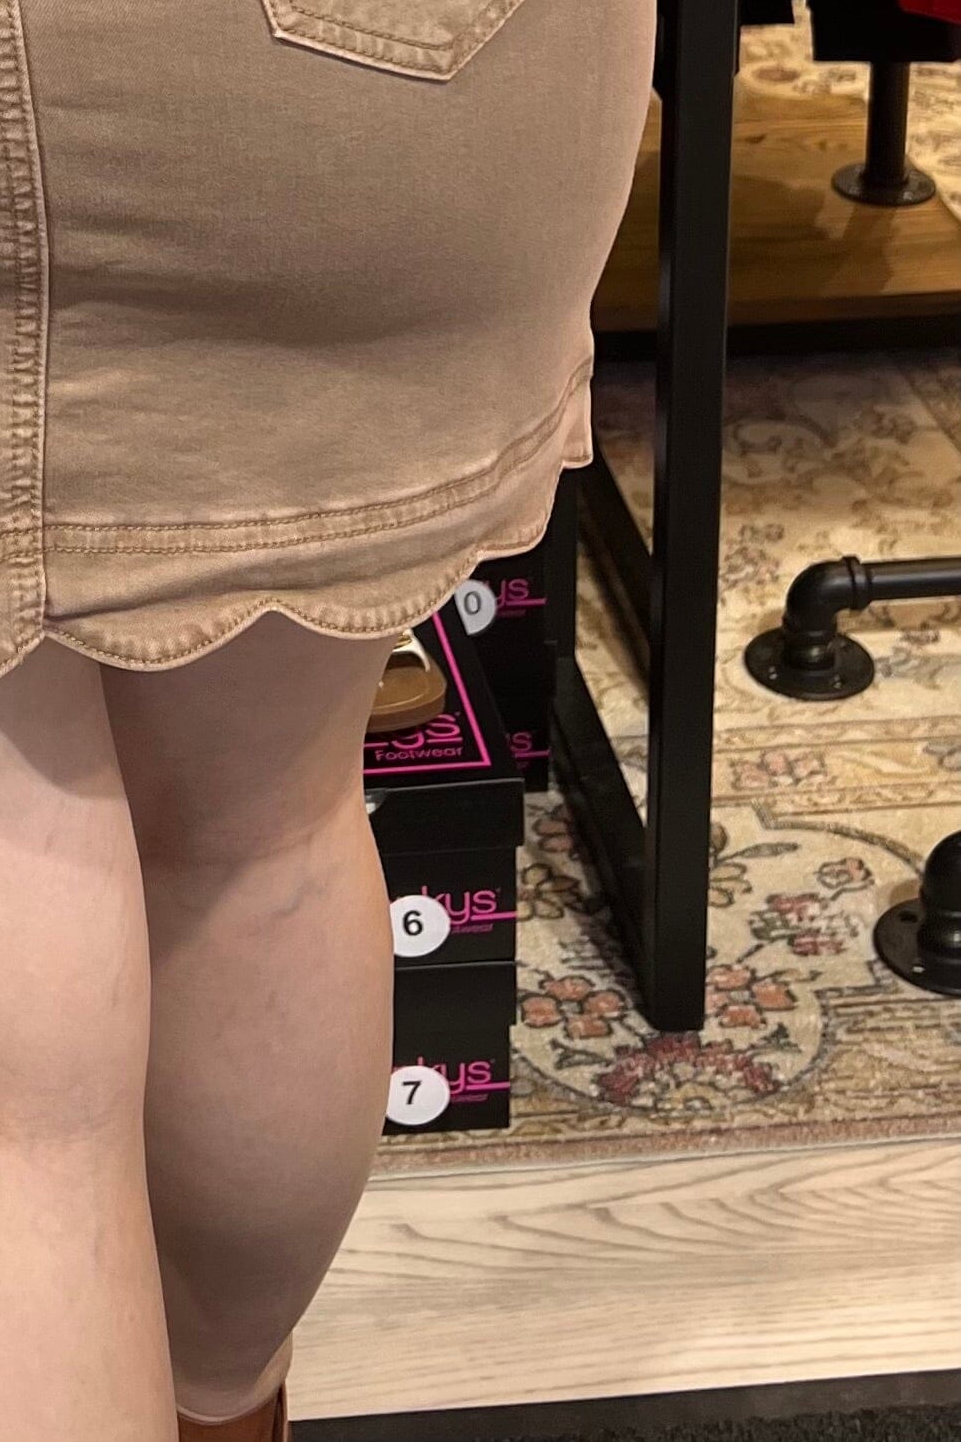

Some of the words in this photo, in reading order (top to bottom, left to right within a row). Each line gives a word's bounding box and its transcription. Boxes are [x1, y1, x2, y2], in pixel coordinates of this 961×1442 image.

[463, 590, 482, 615] 0
[374, 746, 464, 762] Footwear
[402, 909, 424, 937] 6
[401, 1080, 422, 1106] 7
